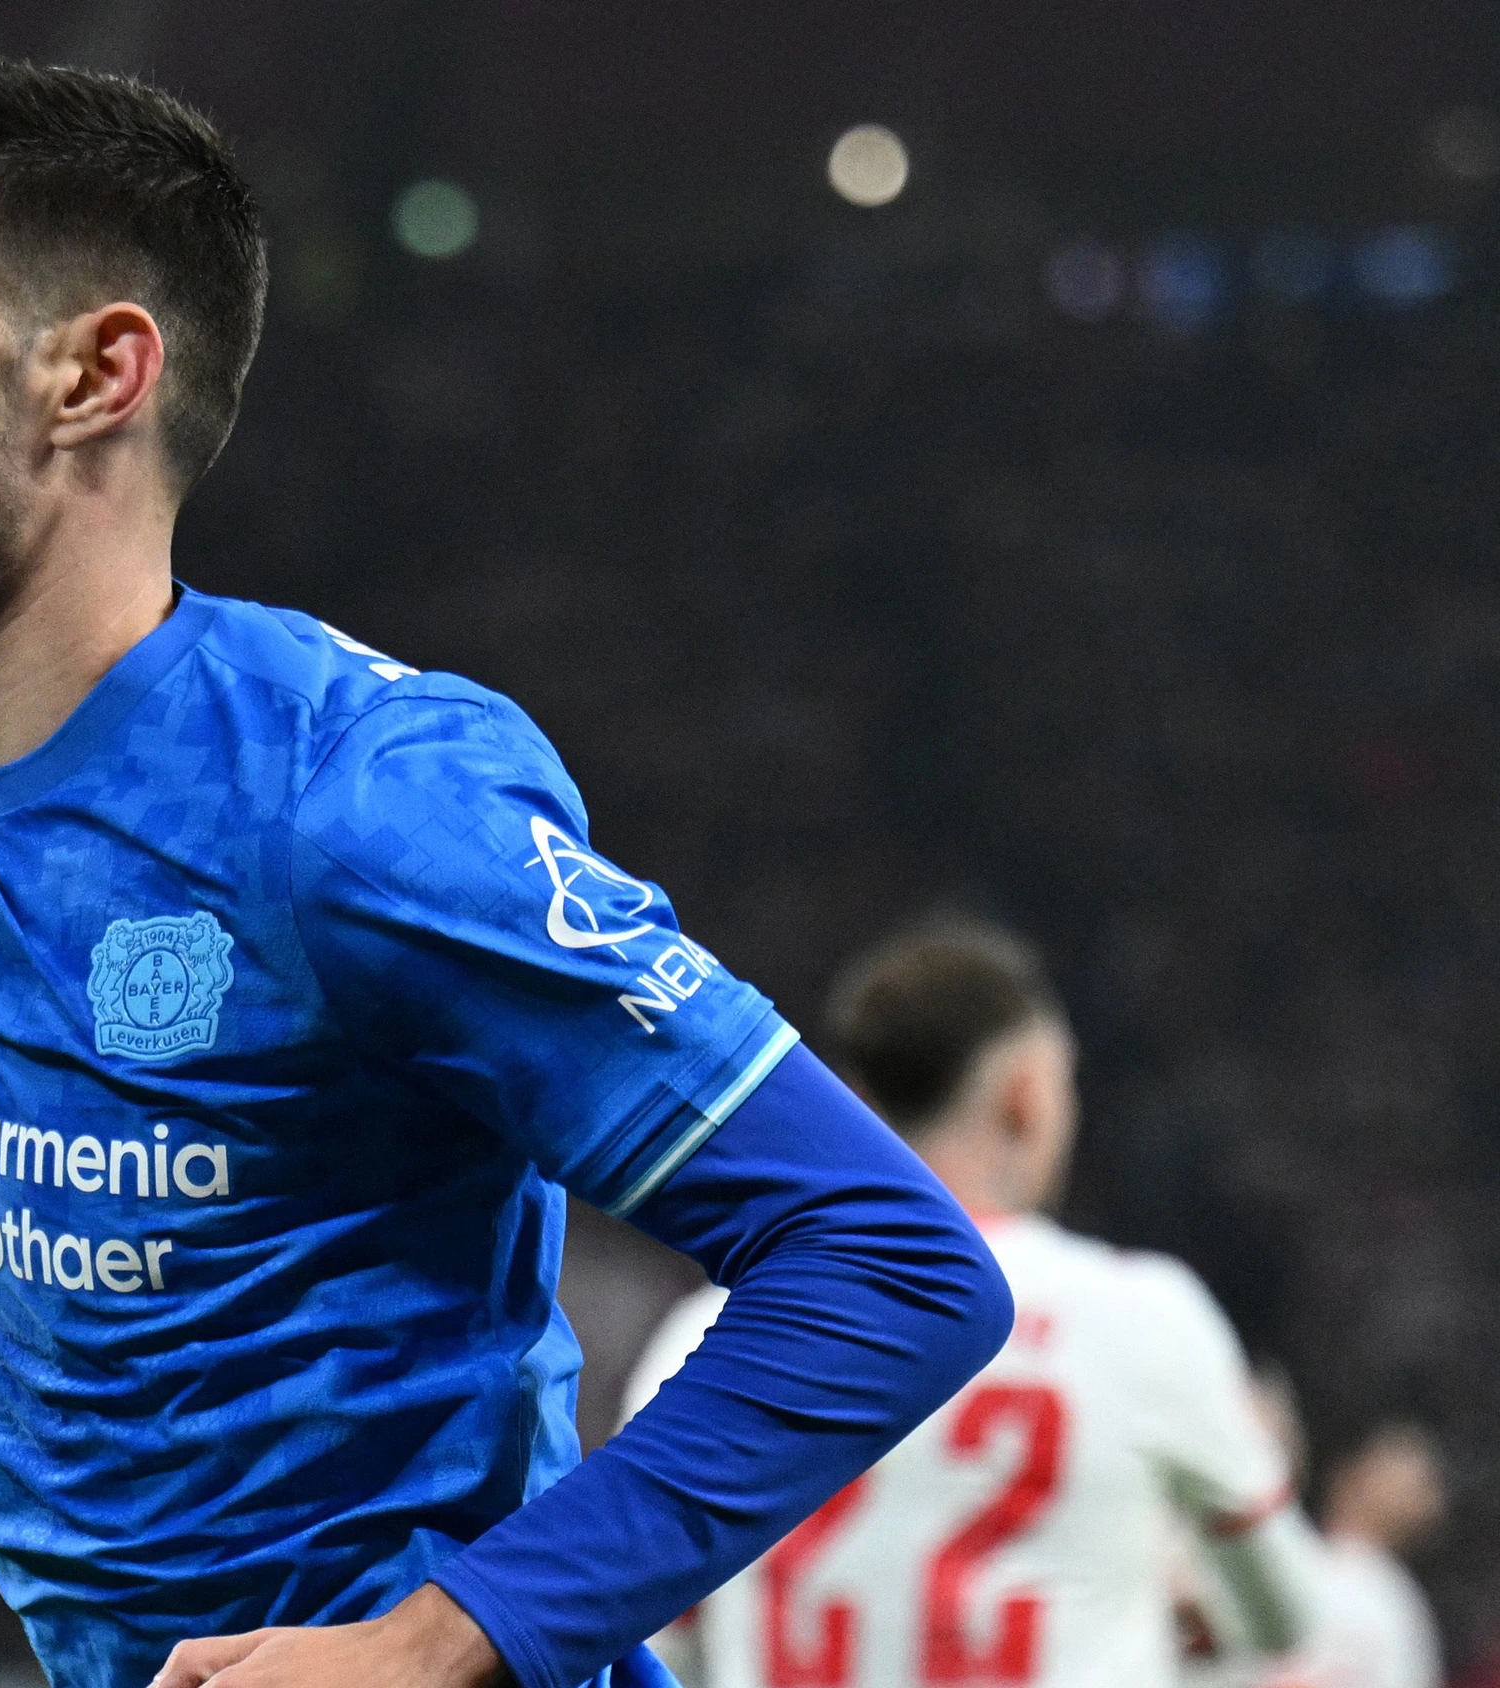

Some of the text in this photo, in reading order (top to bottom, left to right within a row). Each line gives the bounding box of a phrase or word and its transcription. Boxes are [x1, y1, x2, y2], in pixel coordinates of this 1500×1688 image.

[144, 932, 175, 945] 1904
[128, 983, 185, 998] BAYER
[108, 1025, 201, 1051] Leverkusen
